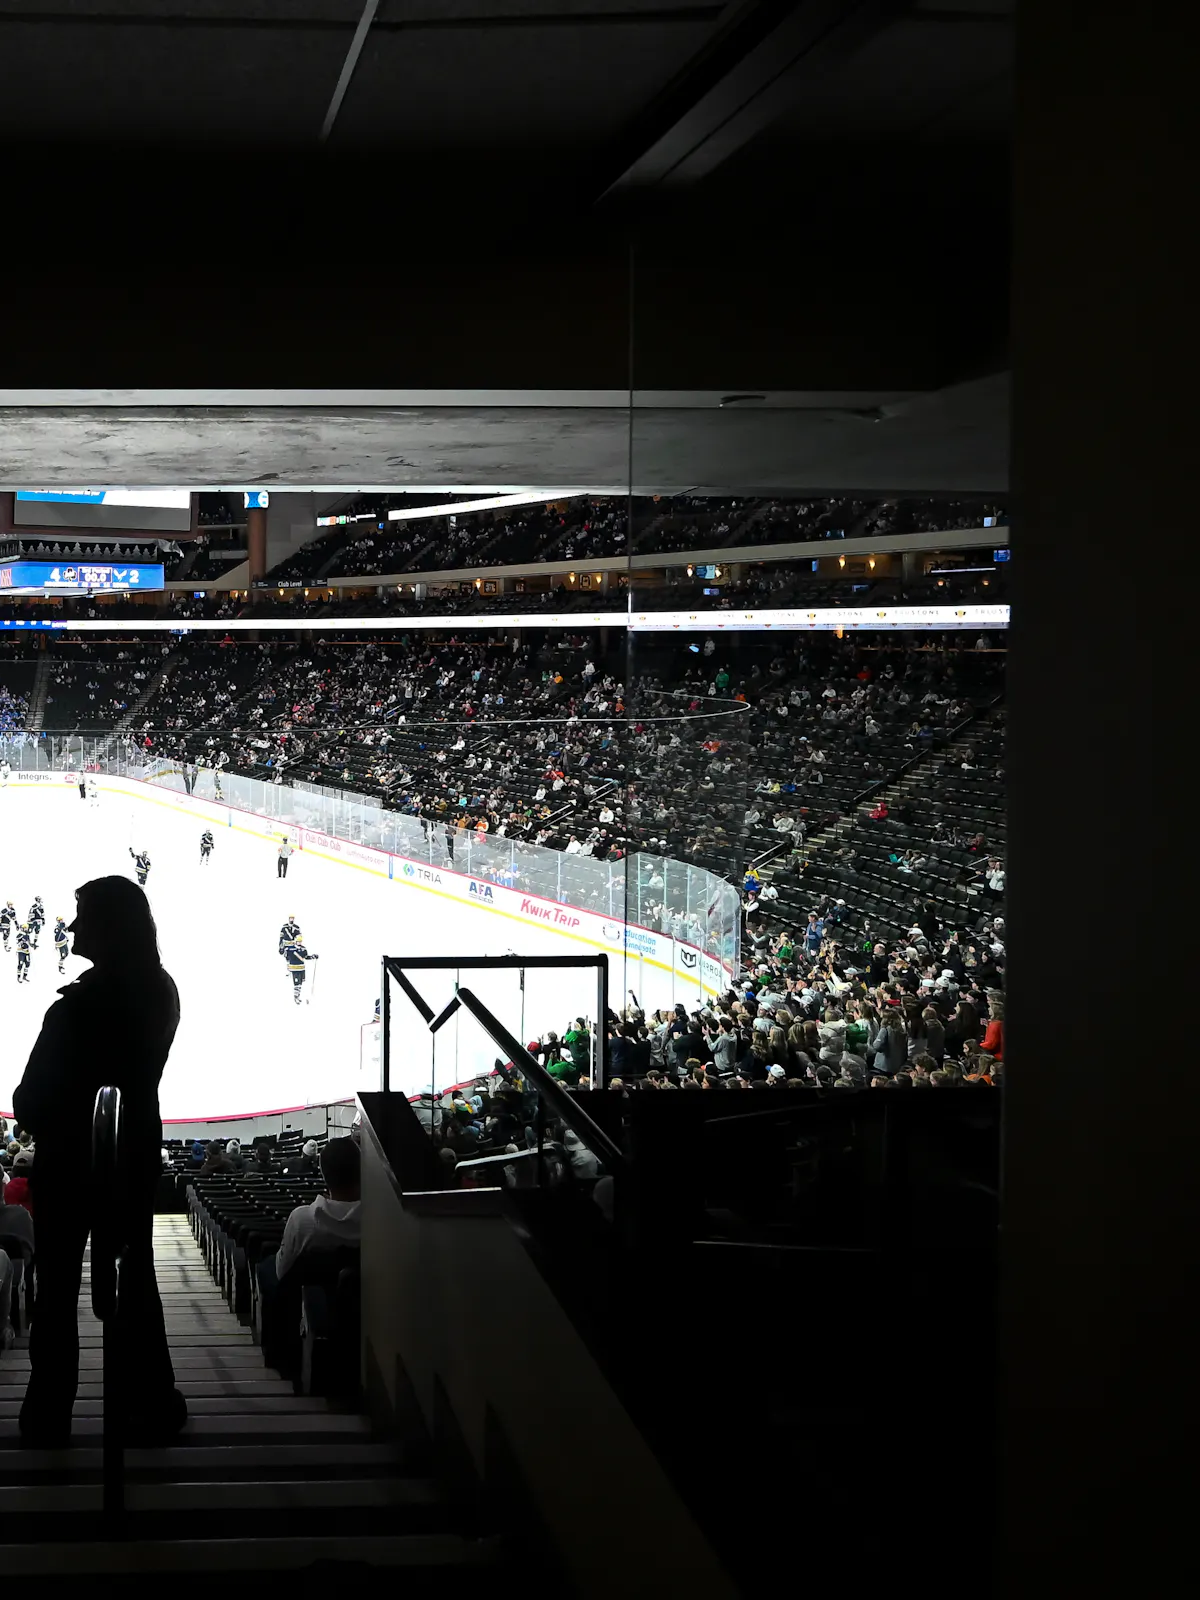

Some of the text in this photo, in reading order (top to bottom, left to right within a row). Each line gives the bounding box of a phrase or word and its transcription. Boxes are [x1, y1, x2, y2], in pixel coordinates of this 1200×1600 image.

[50, 568, 61, 582] 4
[129, 570, 139, 583] 2
[417, 868, 442, 884] TRIA
[469, 882, 493, 898] AFA
